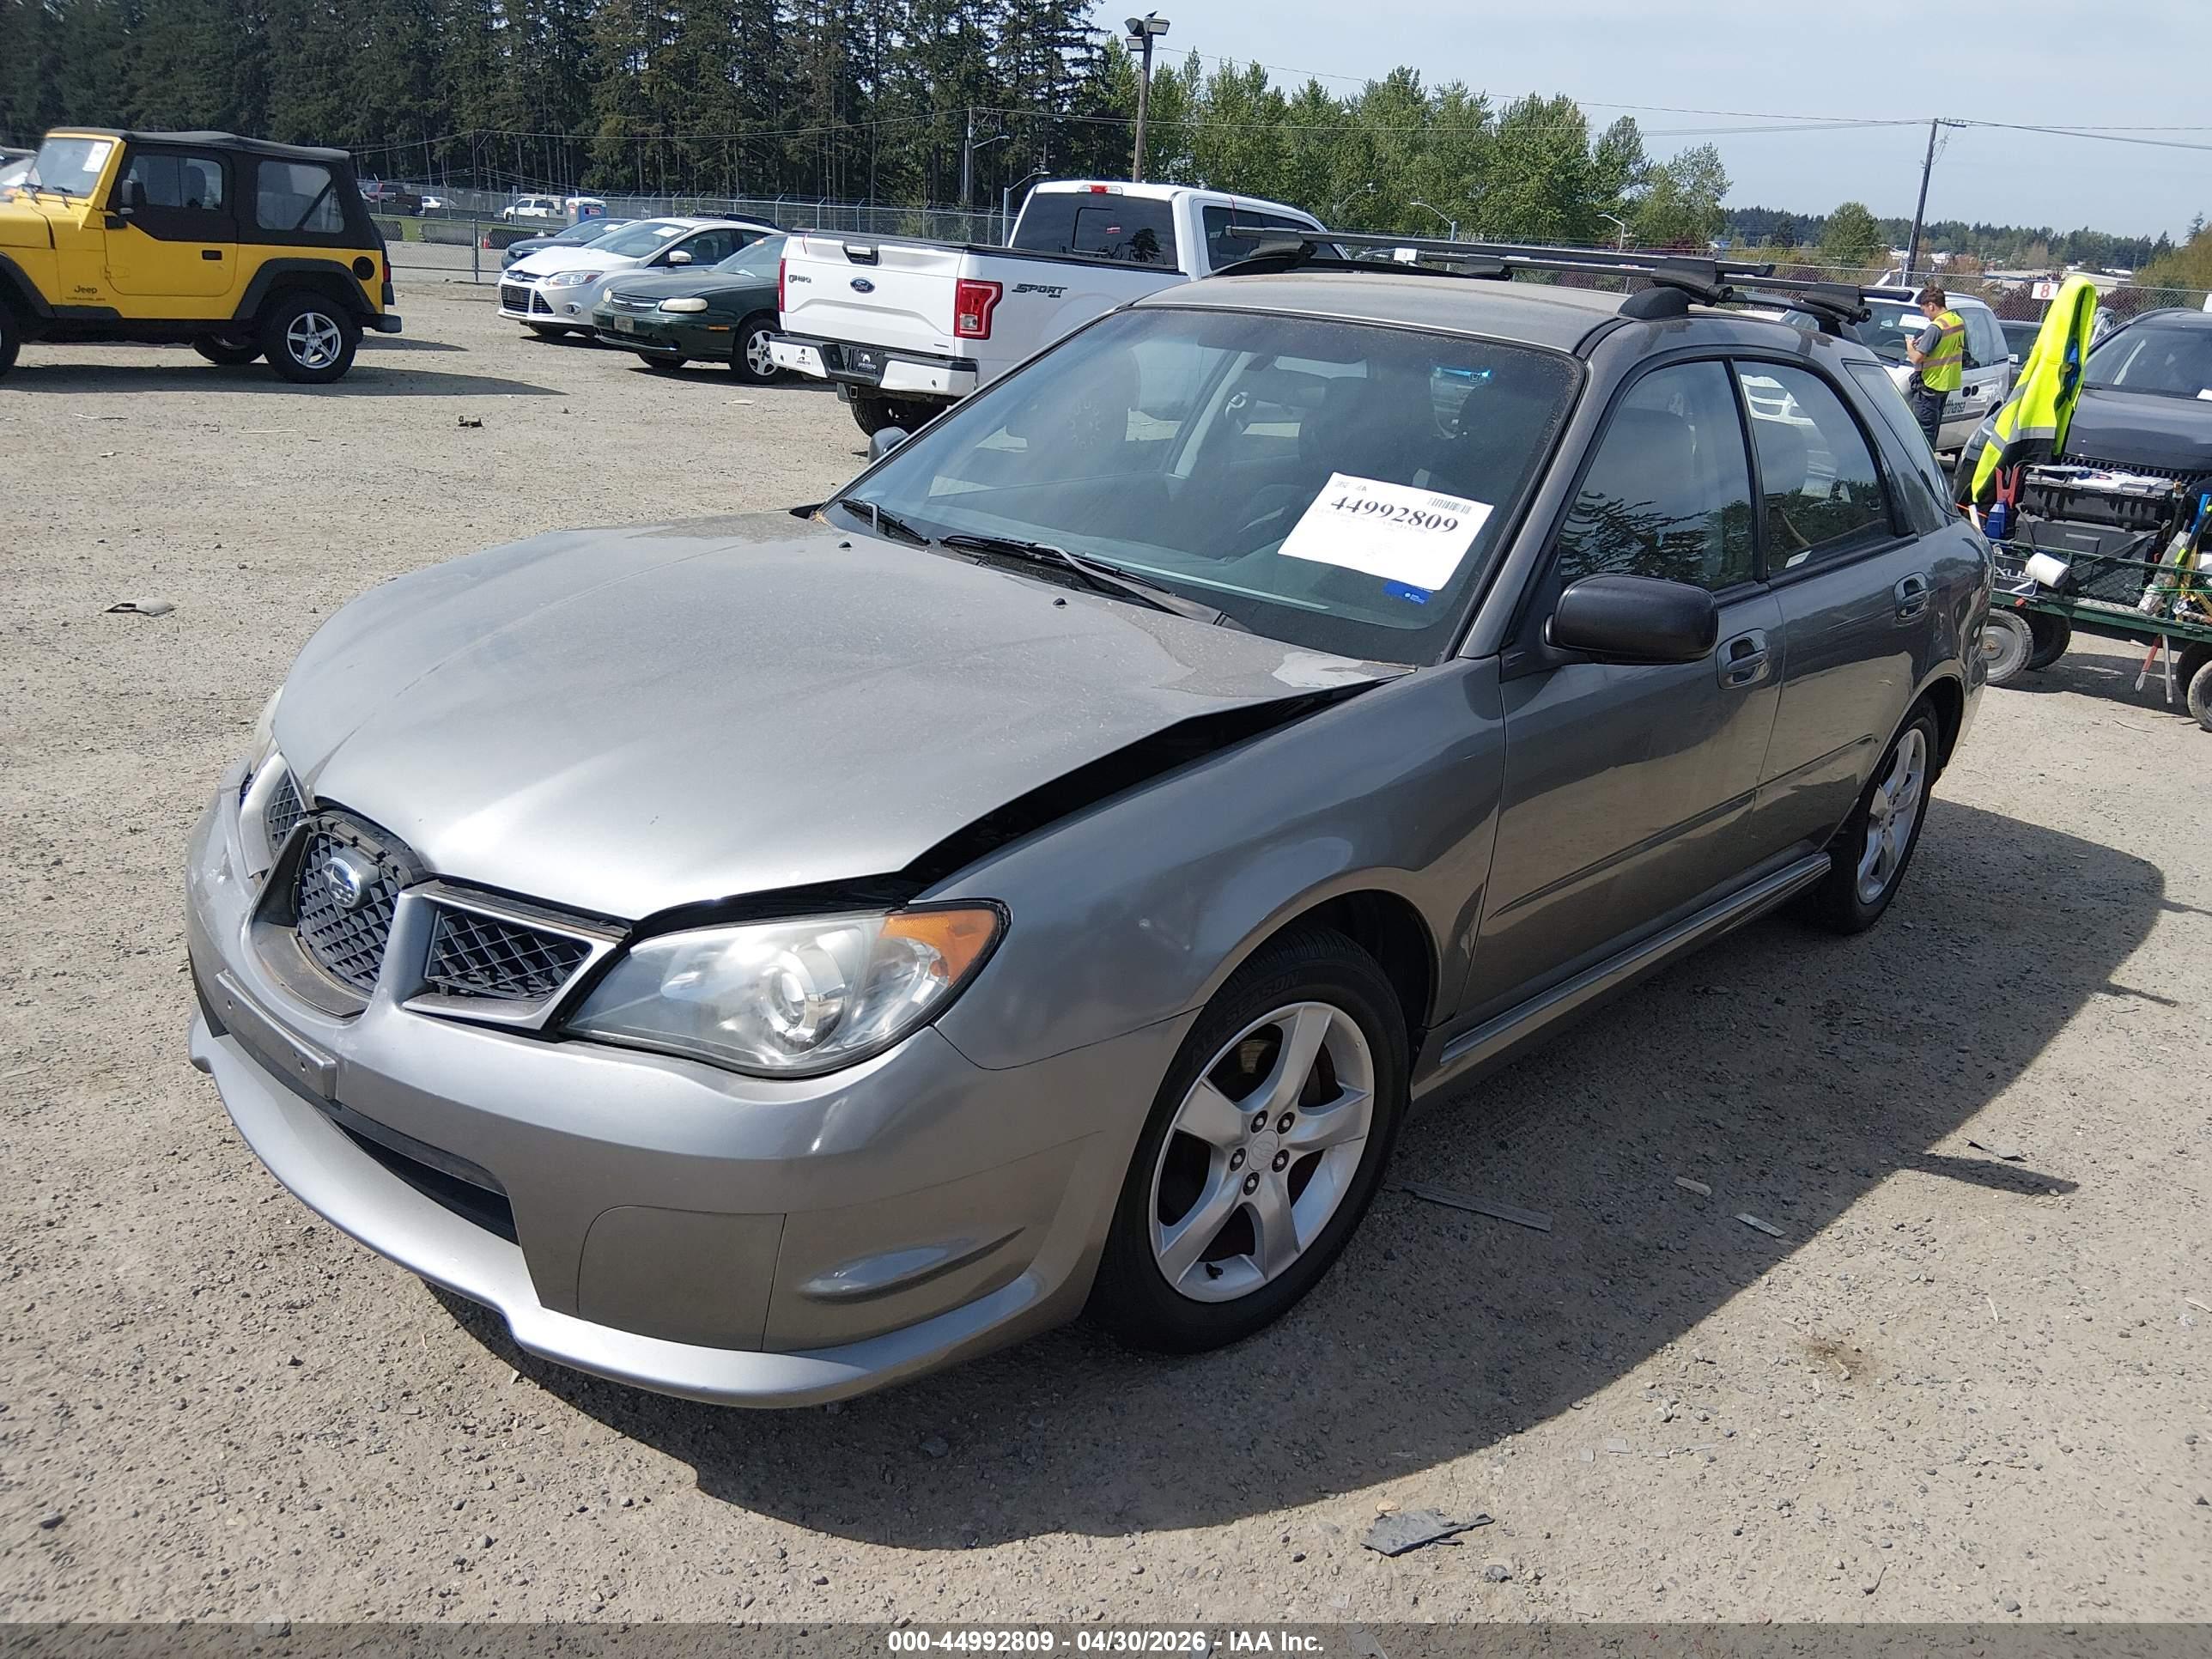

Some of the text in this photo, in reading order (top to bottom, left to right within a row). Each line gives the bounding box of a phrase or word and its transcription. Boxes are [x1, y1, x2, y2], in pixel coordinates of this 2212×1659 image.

[74, 284, 98, 295] Jeep
[1011, 283, 1068, 295] SPORT
[2040, 283, 2051, 298] 8
[1330, 495, 1459, 533] 44992809
